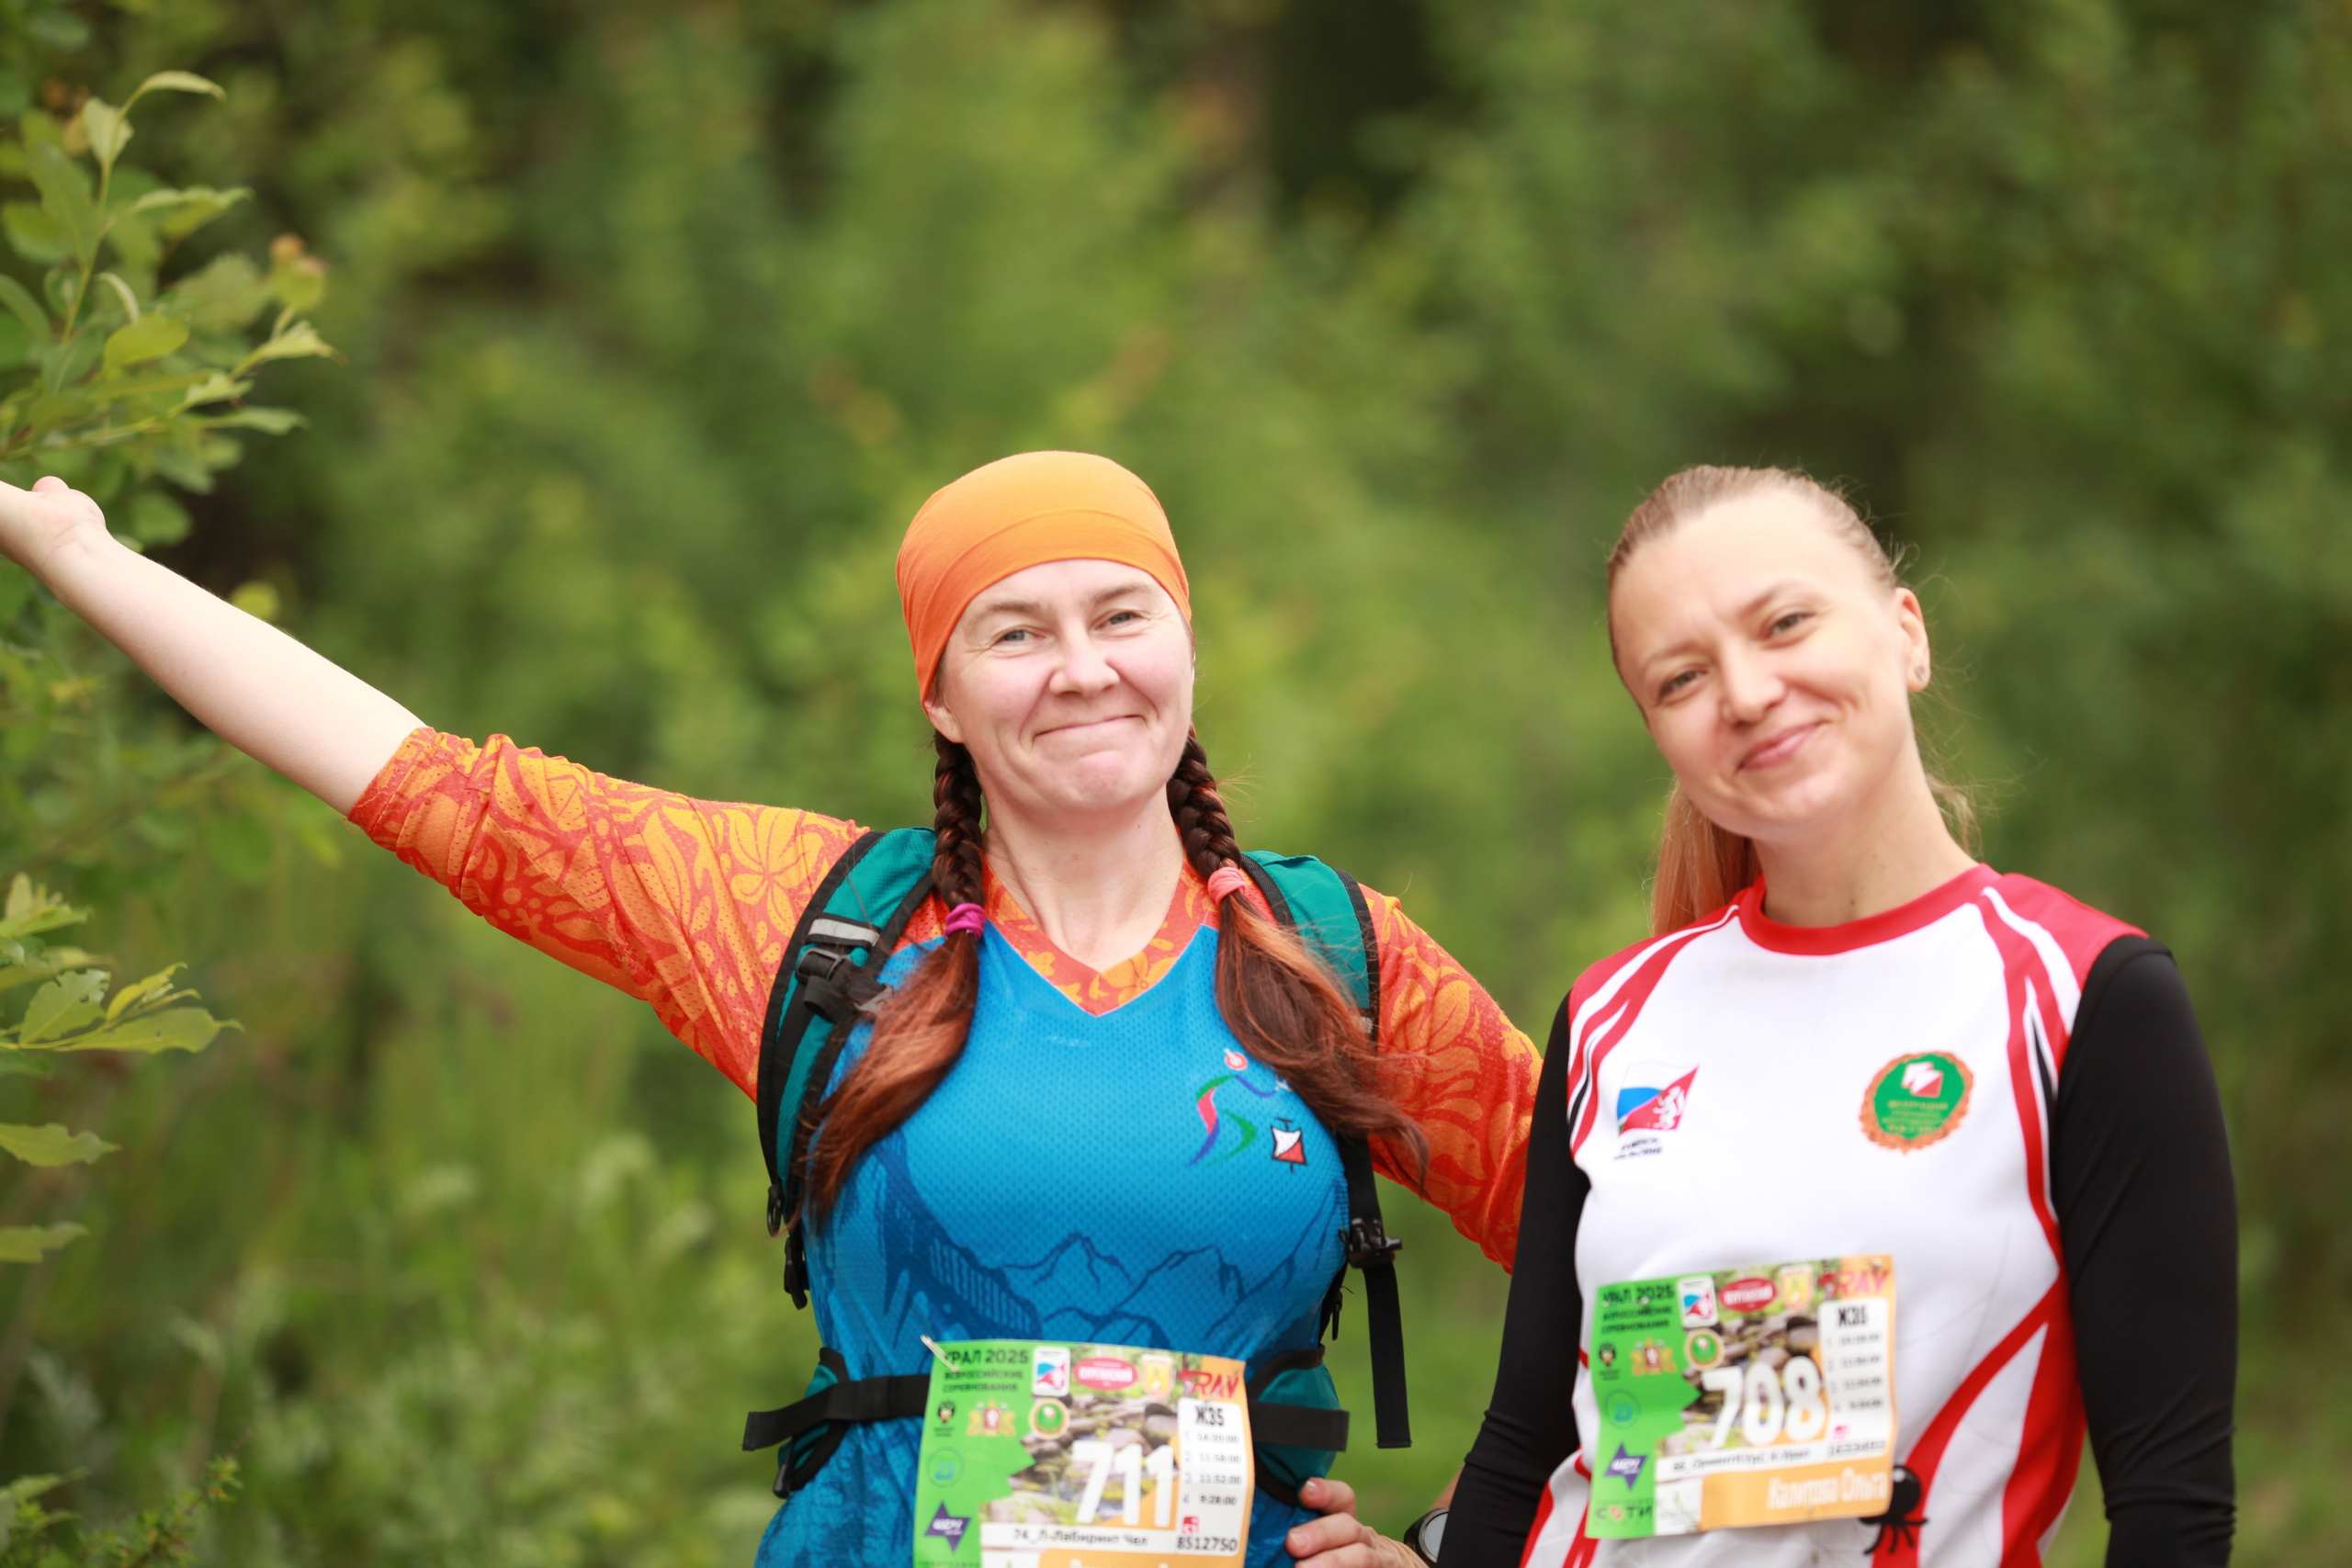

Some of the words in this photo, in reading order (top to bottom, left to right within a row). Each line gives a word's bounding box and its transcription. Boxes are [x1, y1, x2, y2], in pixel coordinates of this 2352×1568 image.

[986, 1348, 1029, 1364] 2025
[1702, 1357, 1826, 1449] 708
[1195, 1405, 1224, 1426] Ж35
[1071, 1440, 1174, 1527] 711
[1177, 1537, 1238, 1551] 8512750
